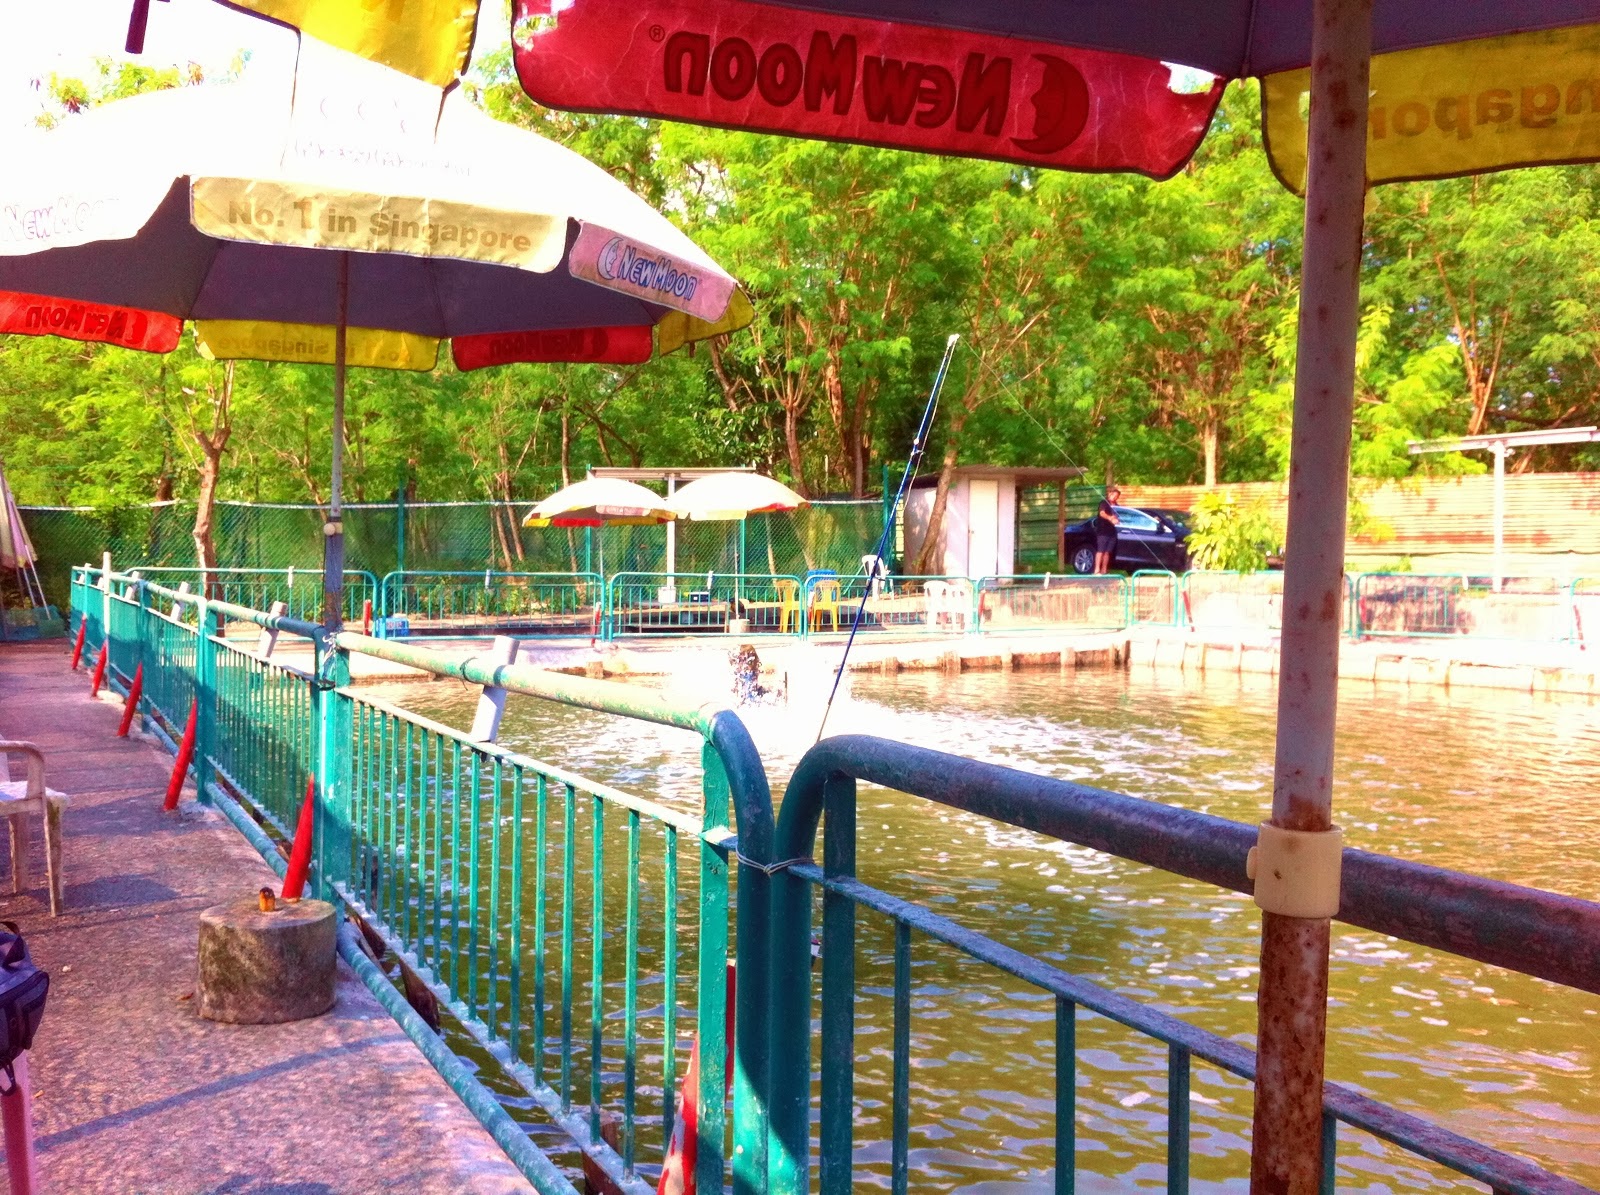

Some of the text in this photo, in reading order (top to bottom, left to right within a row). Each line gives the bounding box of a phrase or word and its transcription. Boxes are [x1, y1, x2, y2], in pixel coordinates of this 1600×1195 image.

[228, 200, 532, 251] No. 1 in Singapore
